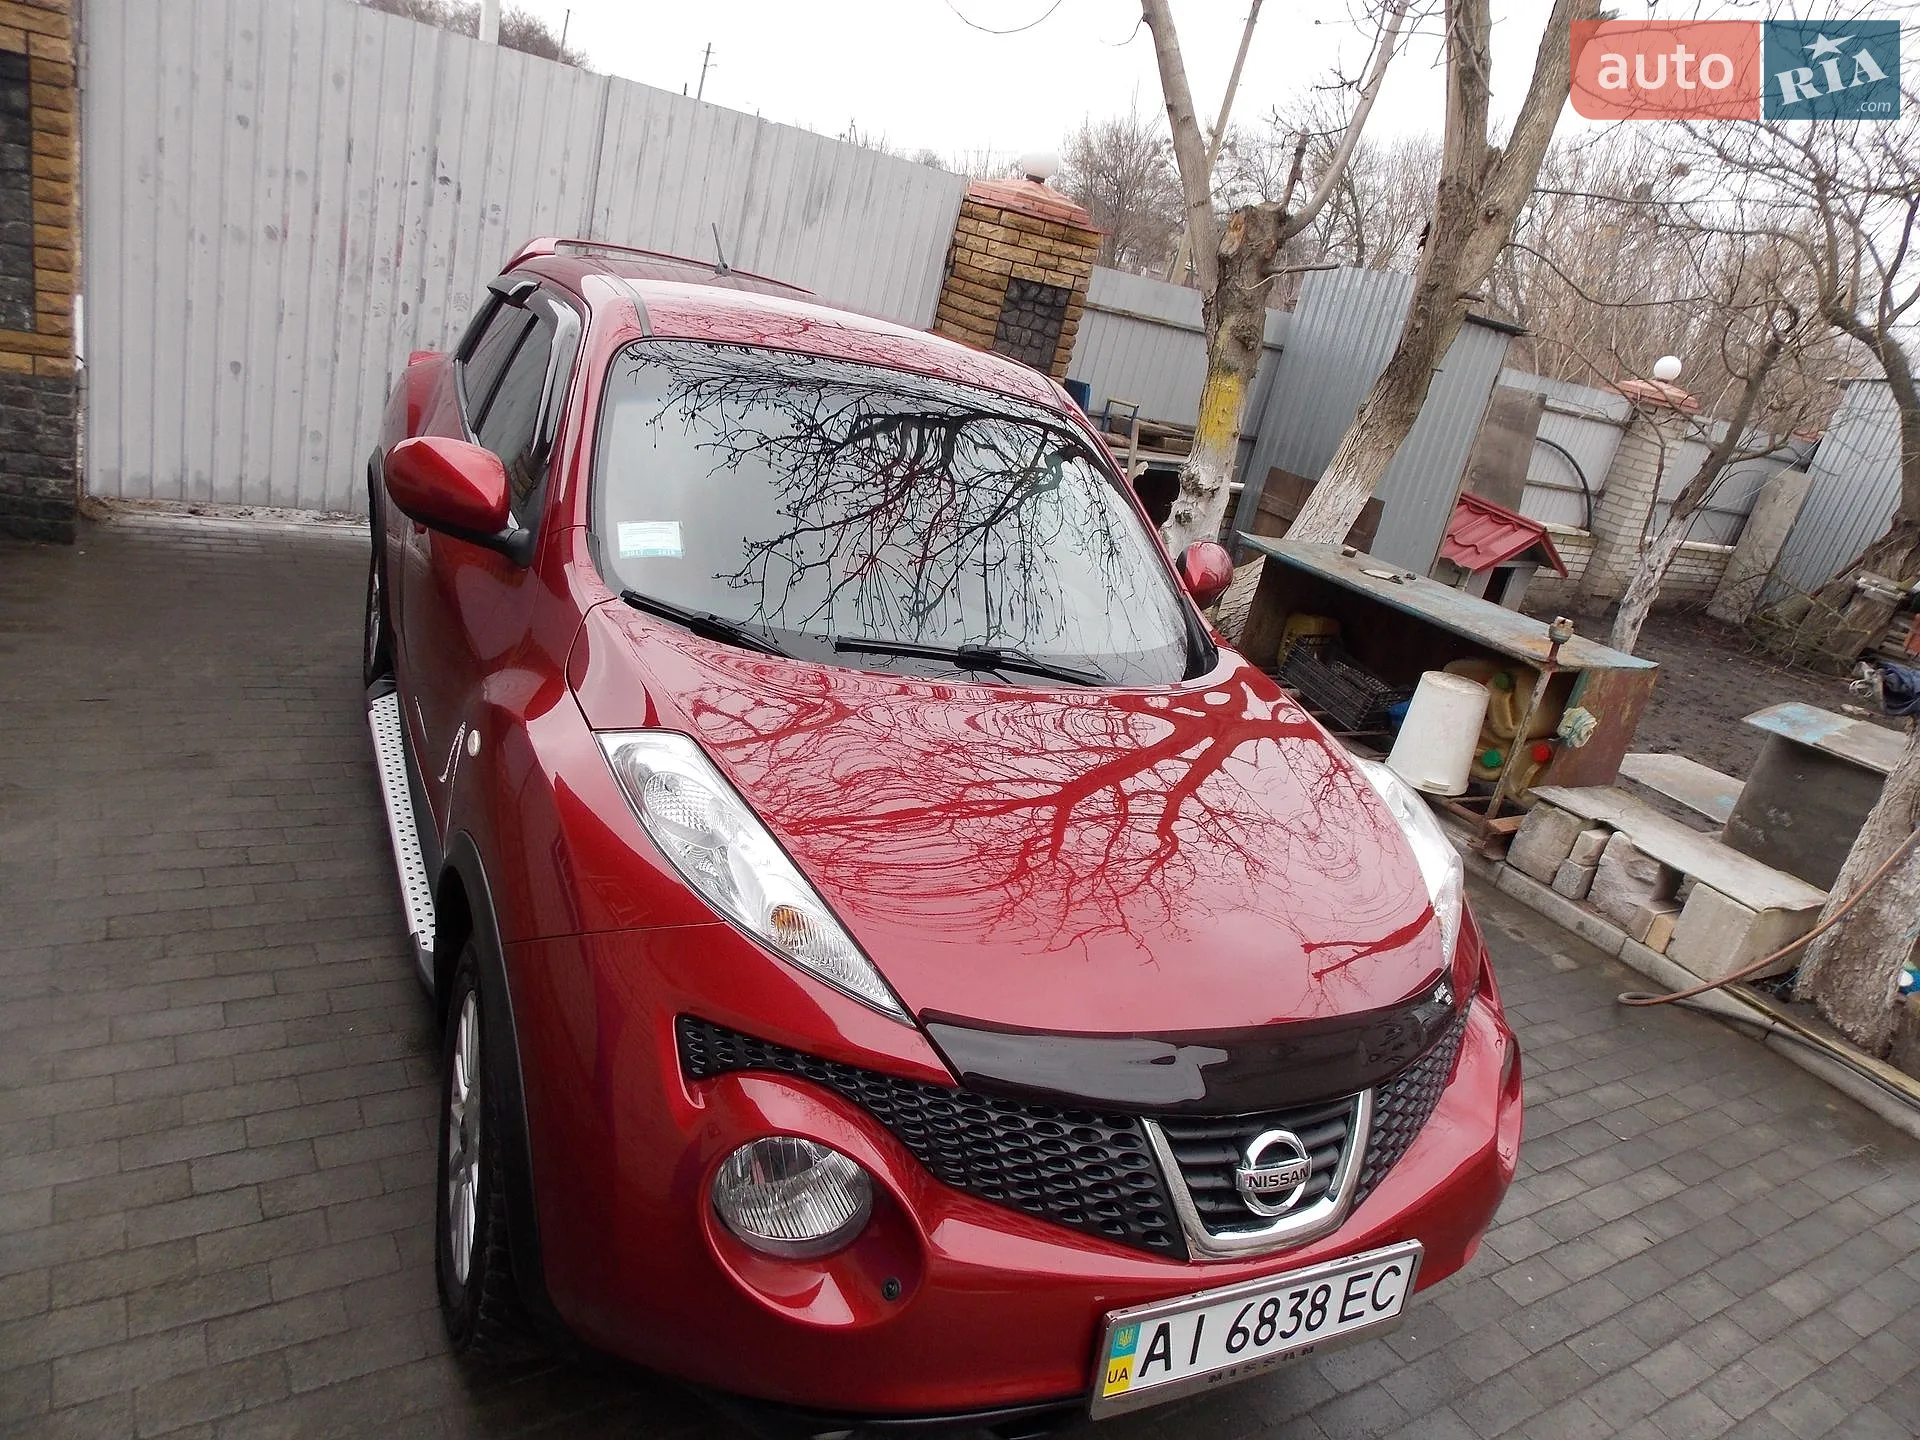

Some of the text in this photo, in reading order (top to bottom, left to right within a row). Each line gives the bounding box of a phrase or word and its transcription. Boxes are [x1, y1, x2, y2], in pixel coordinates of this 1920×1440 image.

[1247, 1166, 1309, 1188] NISSAN
[1137, 1264, 1402, 1378] AI 6838 EC
[1106, 1368, 1129, 1384] UA
